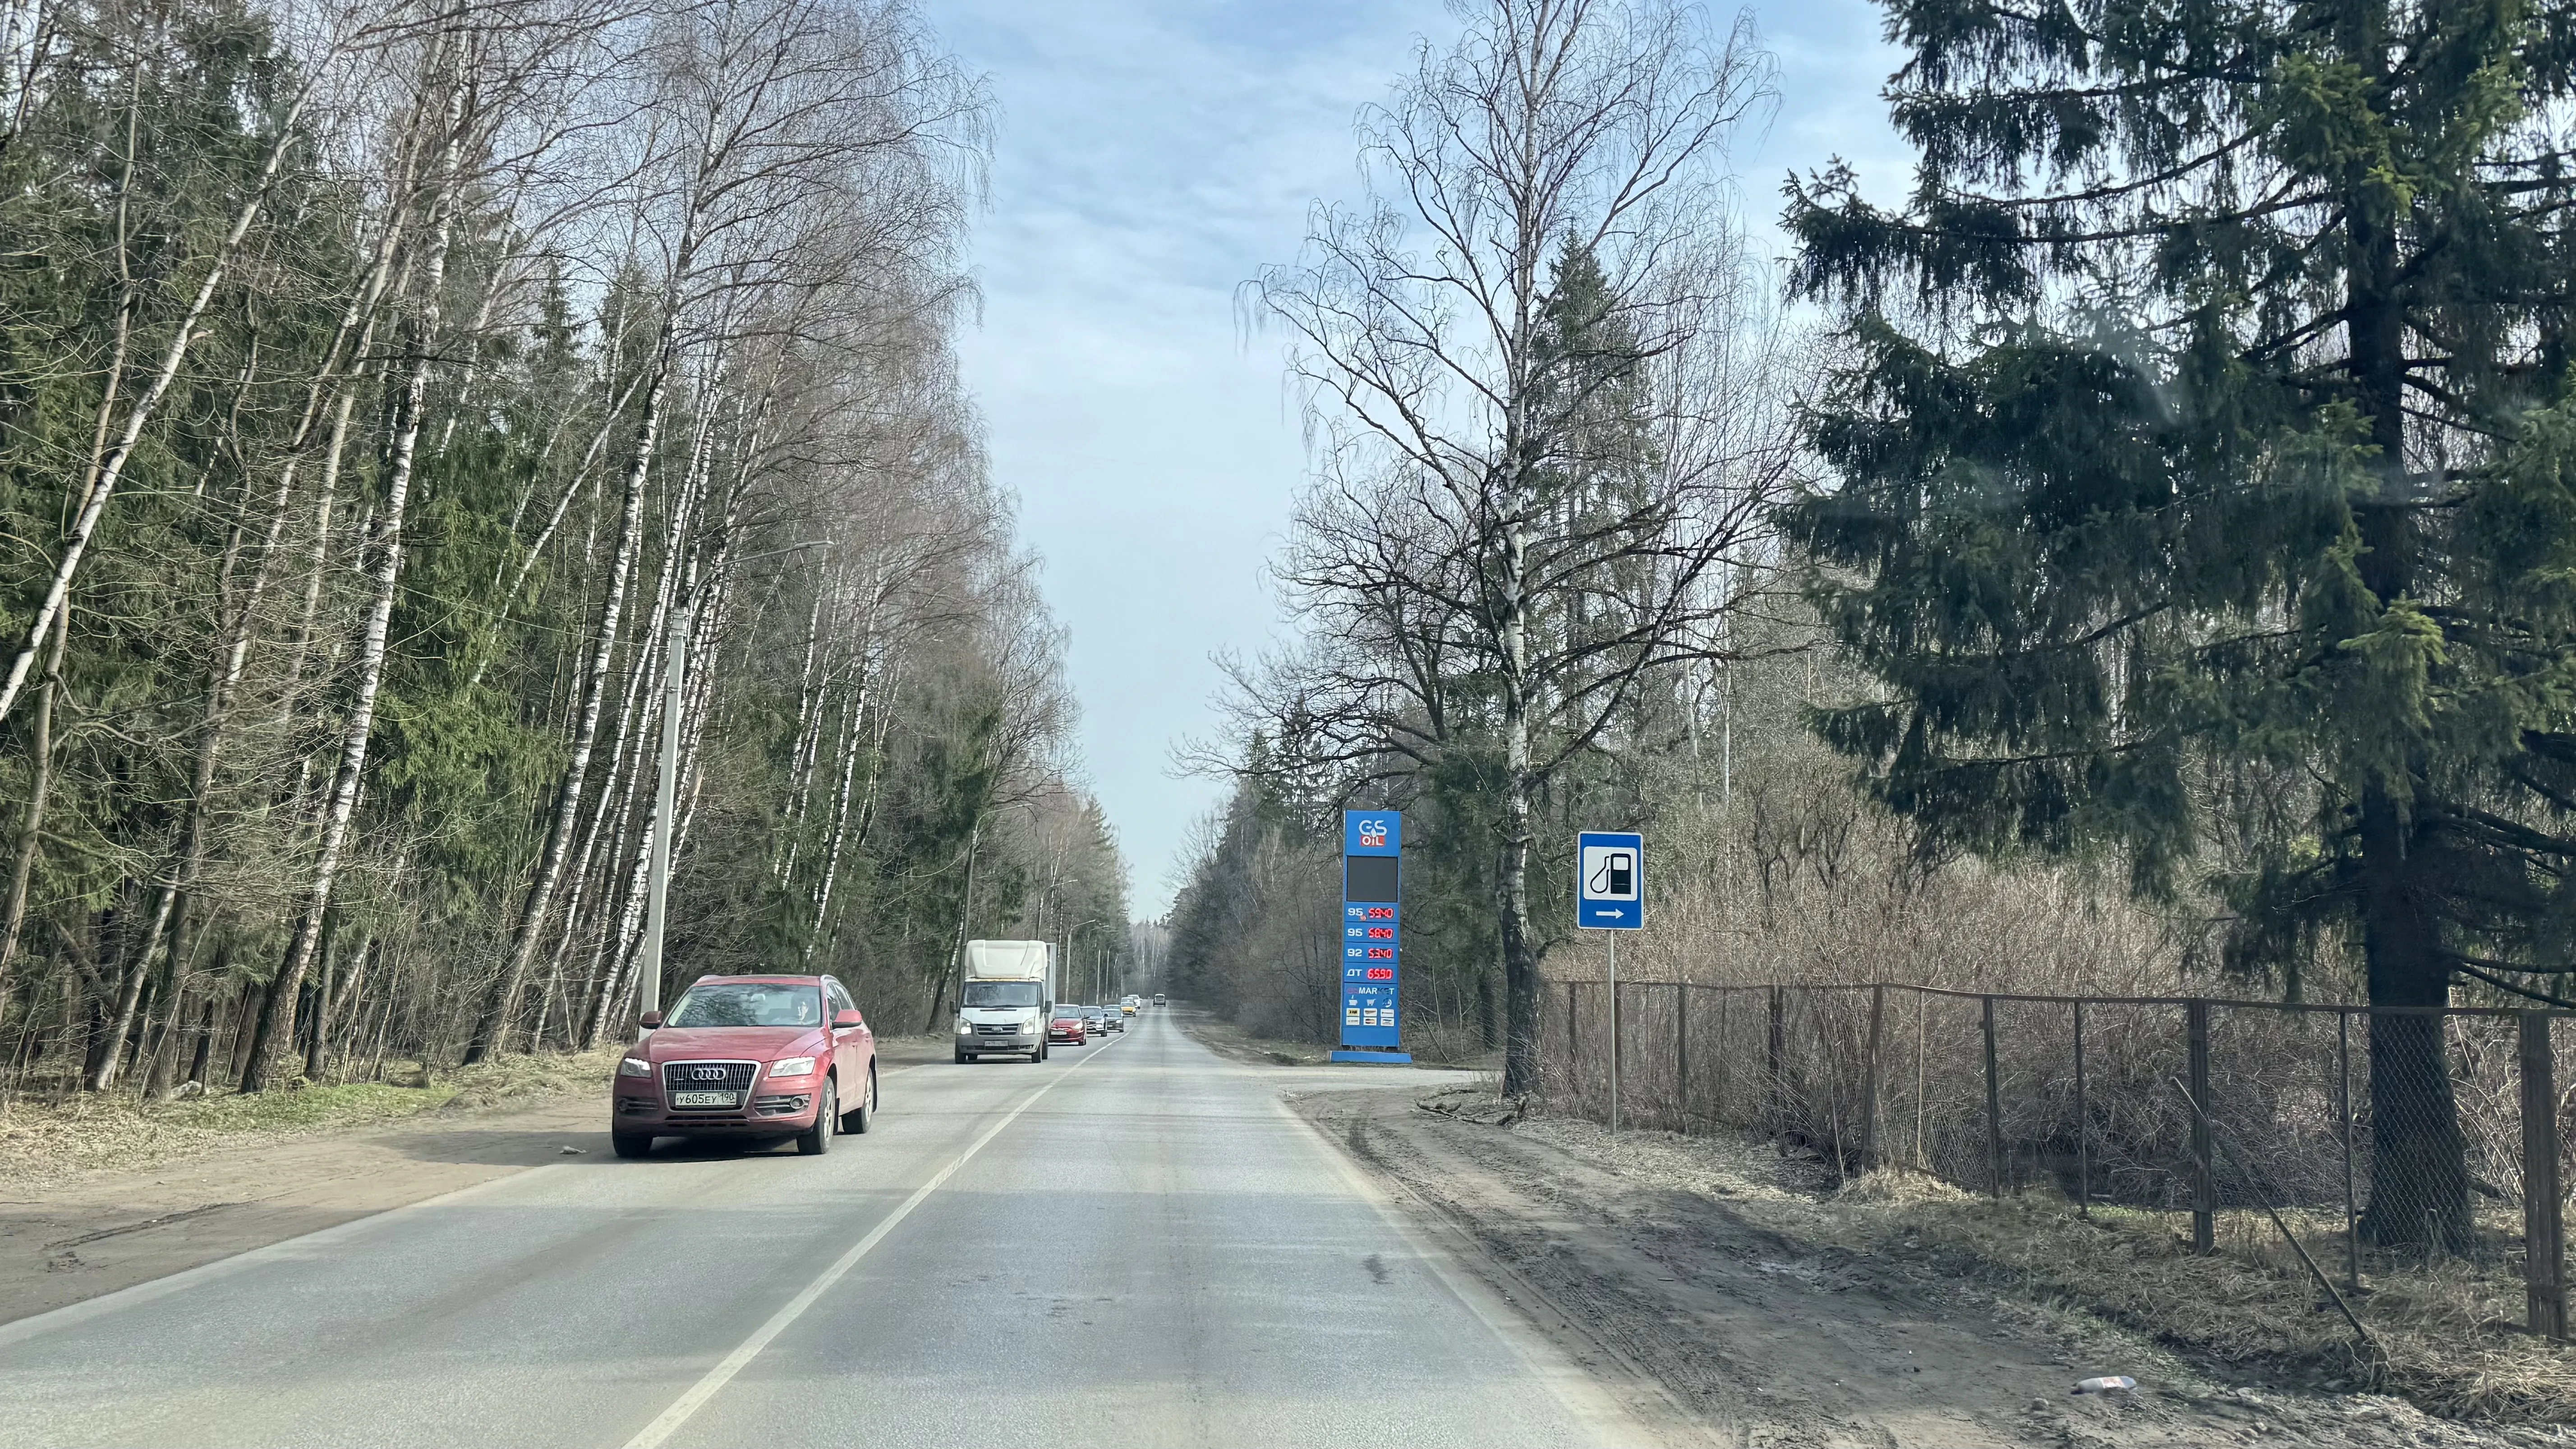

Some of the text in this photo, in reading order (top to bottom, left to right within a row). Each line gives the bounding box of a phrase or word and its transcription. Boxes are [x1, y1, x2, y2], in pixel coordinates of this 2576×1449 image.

[1359, 819, 1387, 836] GS
[1348, 908, 1363, 916] 95
[1348, 928, 1363, 936] 95
[1348, 948, 1362, 957] 92
